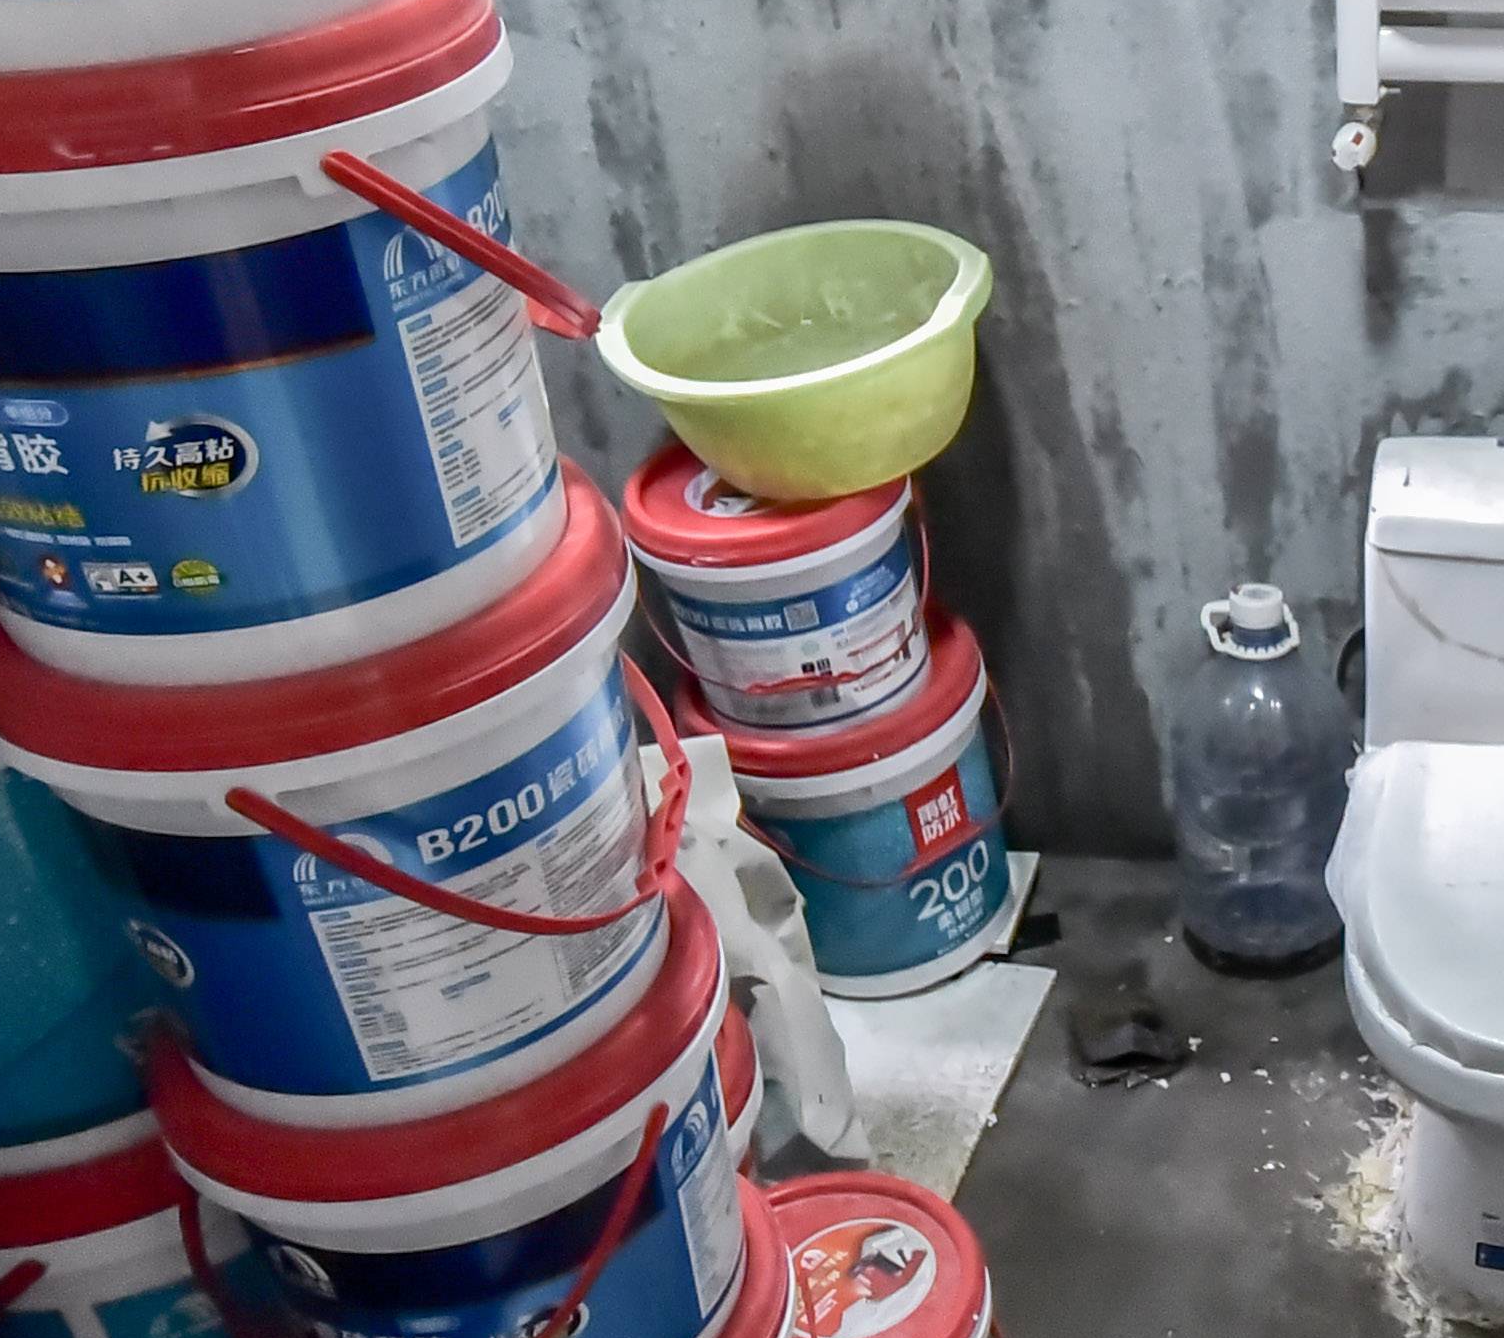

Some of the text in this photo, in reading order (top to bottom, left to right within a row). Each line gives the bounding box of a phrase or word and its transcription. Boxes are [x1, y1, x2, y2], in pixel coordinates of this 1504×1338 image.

[112, 435, 235, 471] 持久高粘
[119, 569, 150, 585] A+
[909, 840, 989, 921] 200
